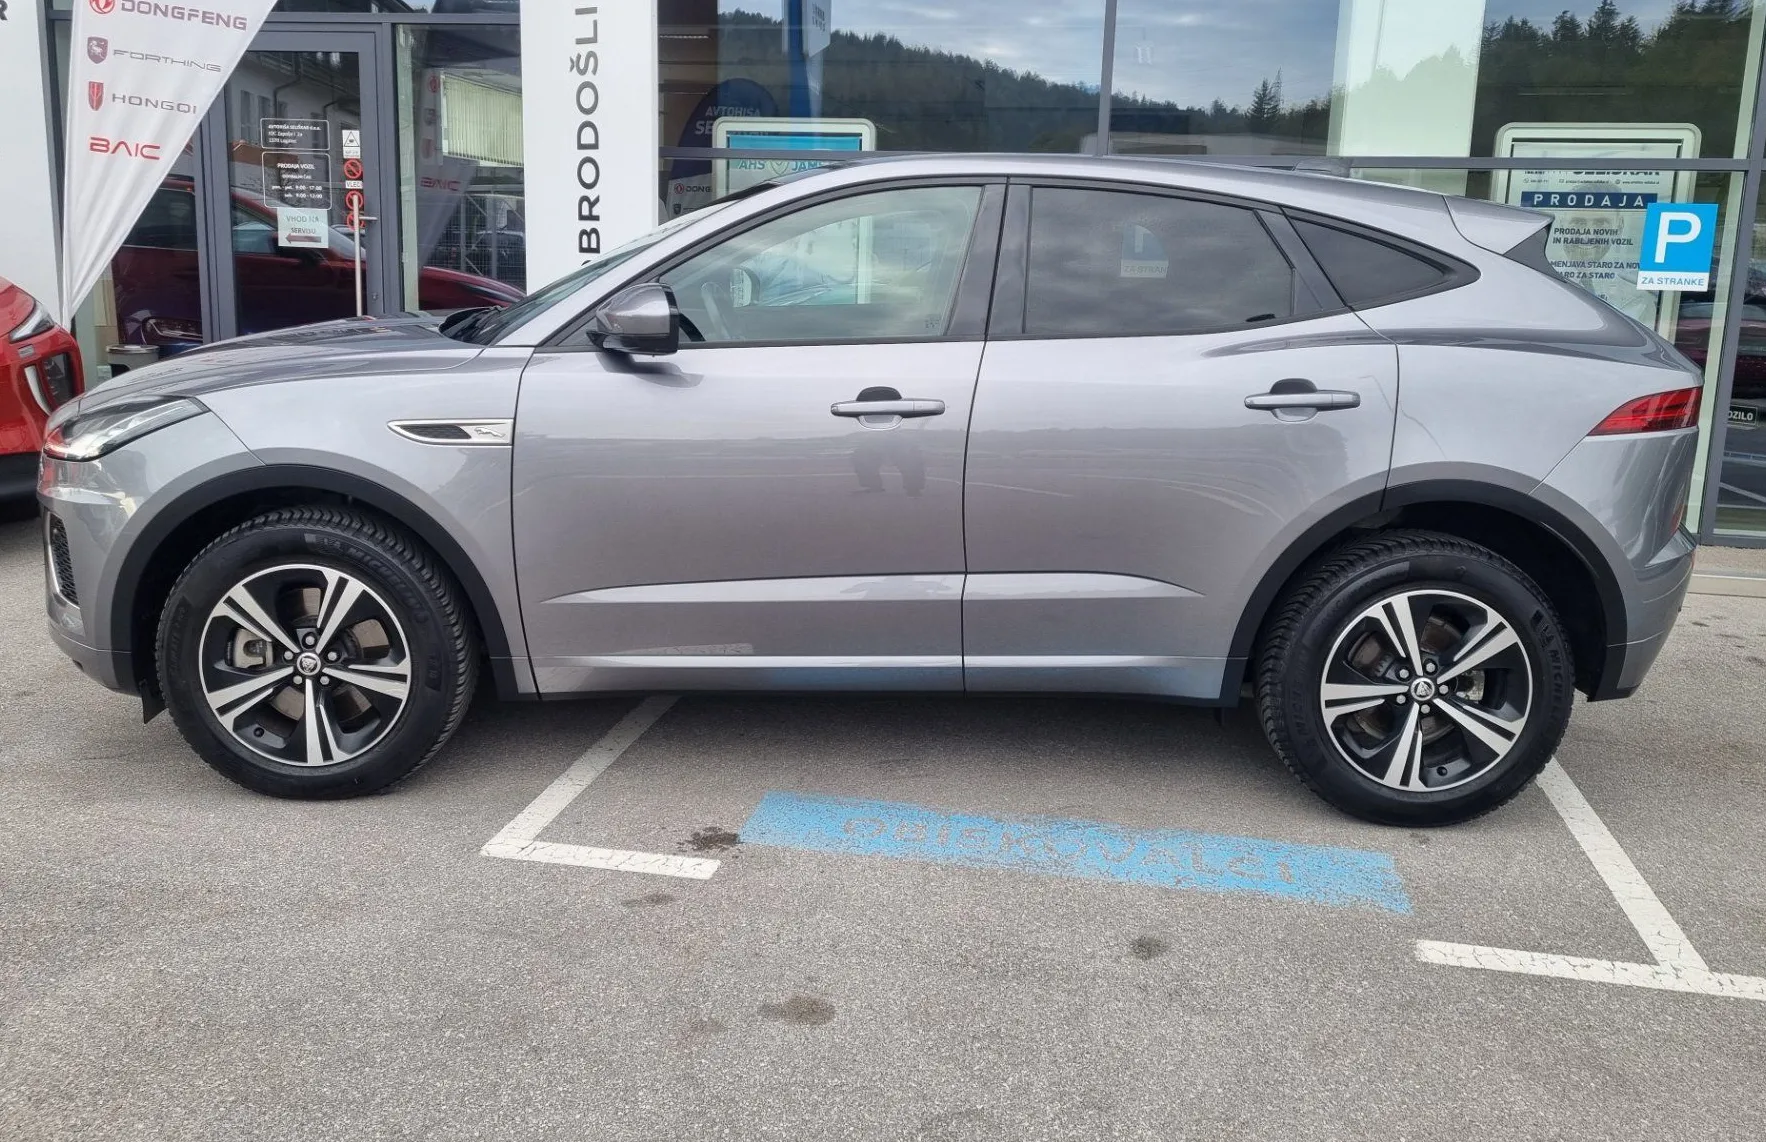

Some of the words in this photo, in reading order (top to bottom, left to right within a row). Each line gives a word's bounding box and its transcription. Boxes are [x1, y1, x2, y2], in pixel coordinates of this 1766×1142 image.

[121, 0, 248, 31] DONGFENG
[113, 49, 222, 72] FORTHING
[111, 93, 197, 115] HONGQI
[570, 6, 601, 267] BRODOŠLI
[89, 136, 161, 161] BAIC
[686, 185, 712, 193] DONG
[1533, 194, 1644, 207] PRODAJA
[1554, 228, 1592, 236] PRODAJA
[1654, 211, 1702, 264] P
[1563, 238, 1609, 246] RABLJENIH
[1551, 261, 1586, 269] MENJAVA
[1641, 276, 1655, 285] ZA
[1656, 277, 1704, 287] STRANKE
[1728, 410, 1754, 421] OZILO
[843, 815, 1296, 884] OBISKOVALCI
